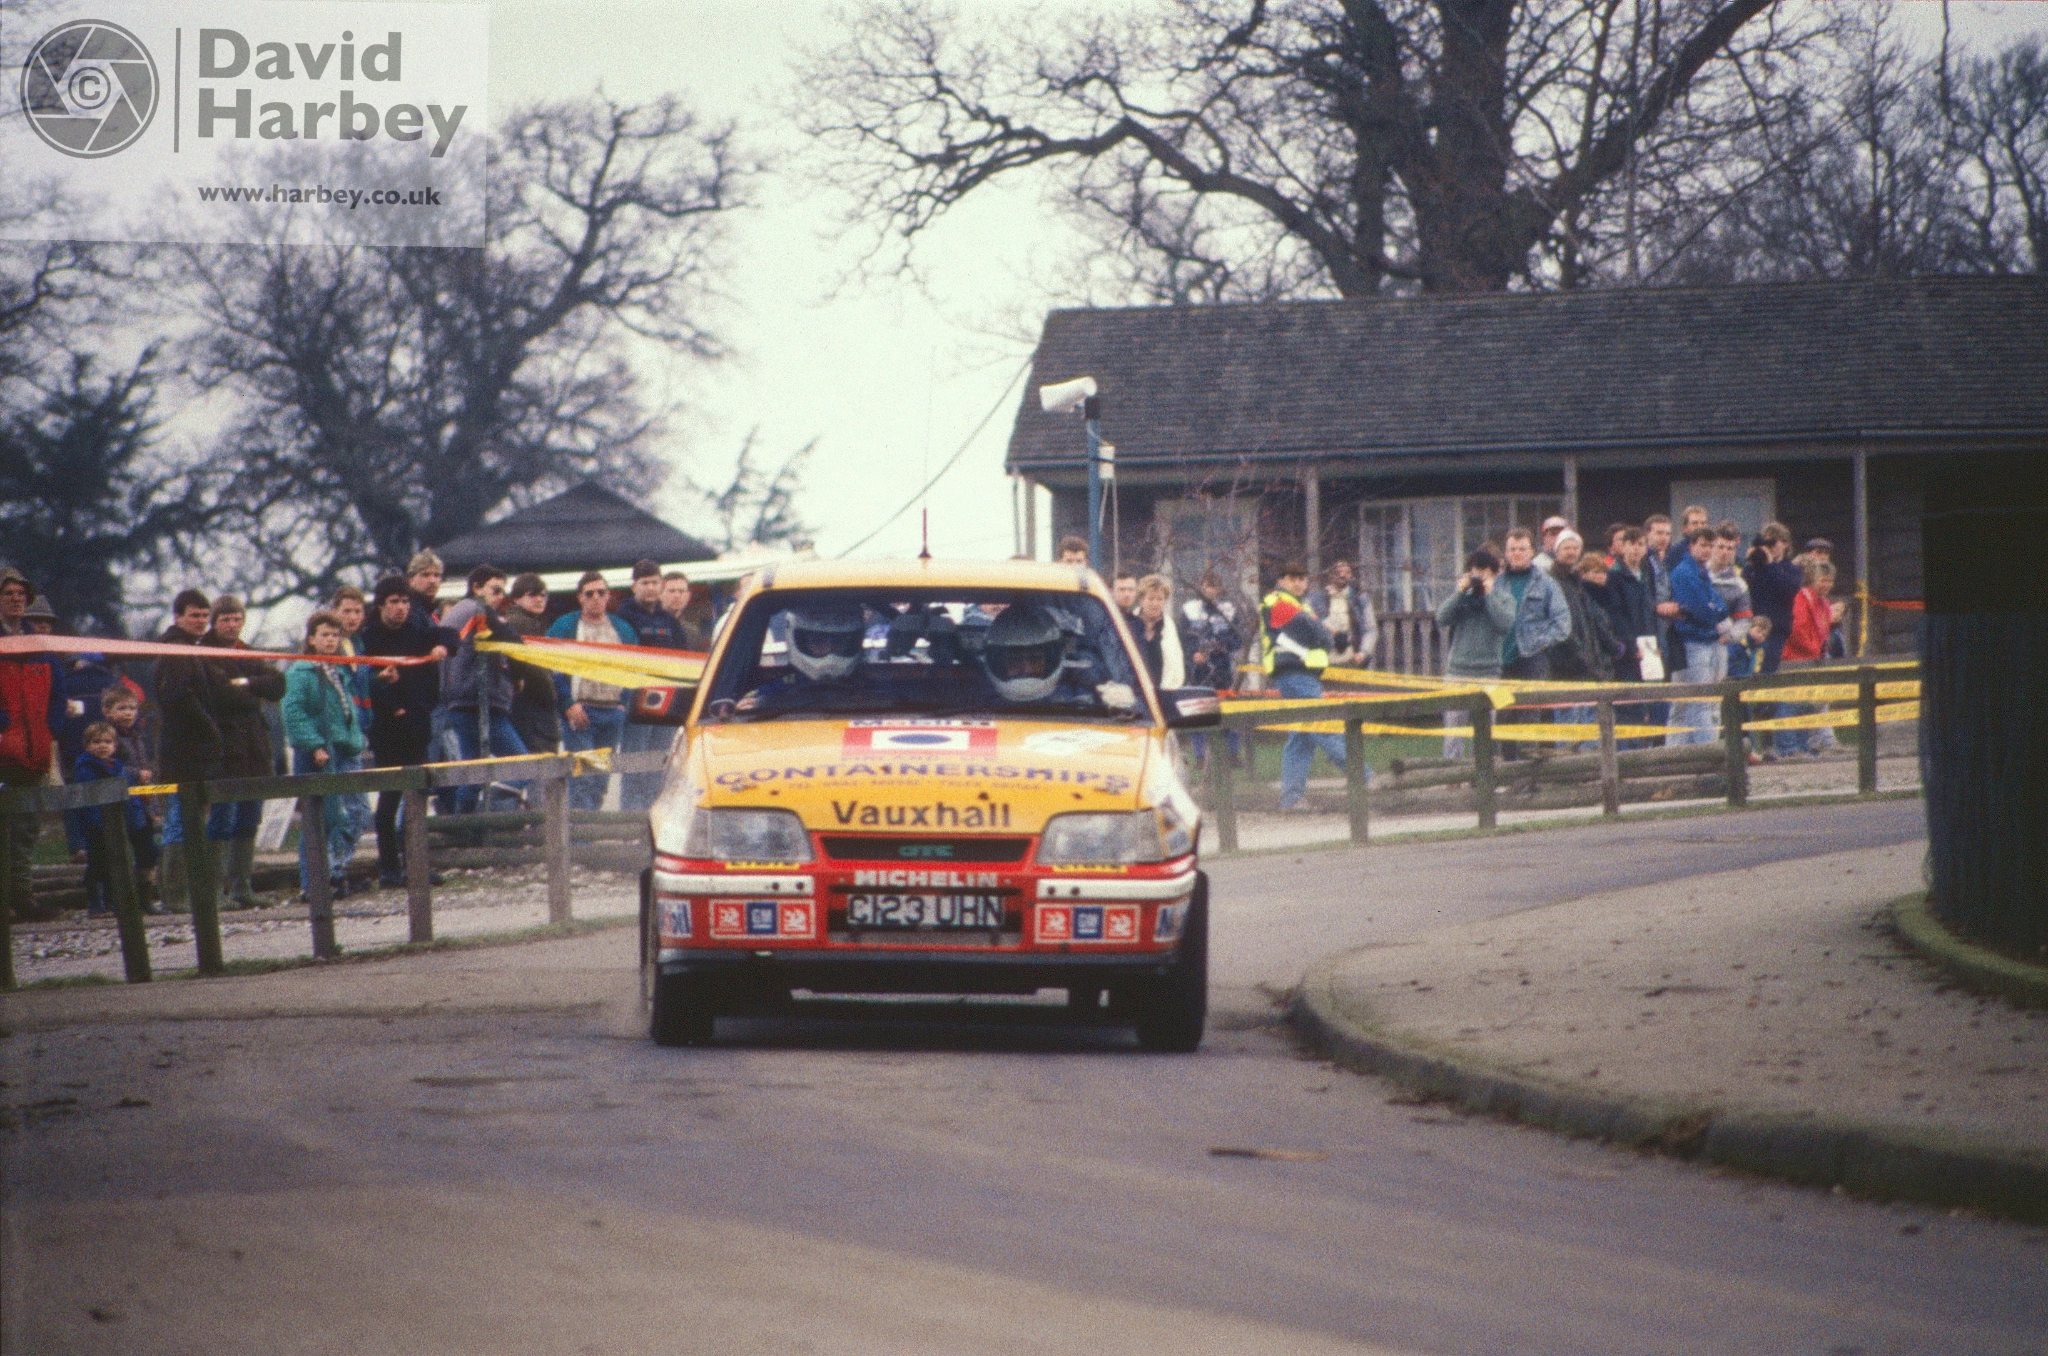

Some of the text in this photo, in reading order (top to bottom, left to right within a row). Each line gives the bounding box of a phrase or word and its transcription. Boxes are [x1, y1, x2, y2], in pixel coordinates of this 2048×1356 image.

[715, 762, 1131, 790] CONTAINERSHIPS
[832, 800, 1011, 828] Vauxhall
[854, 869, 999, 888] MICHELIN
[936, 894, 1004, 926] UHN
